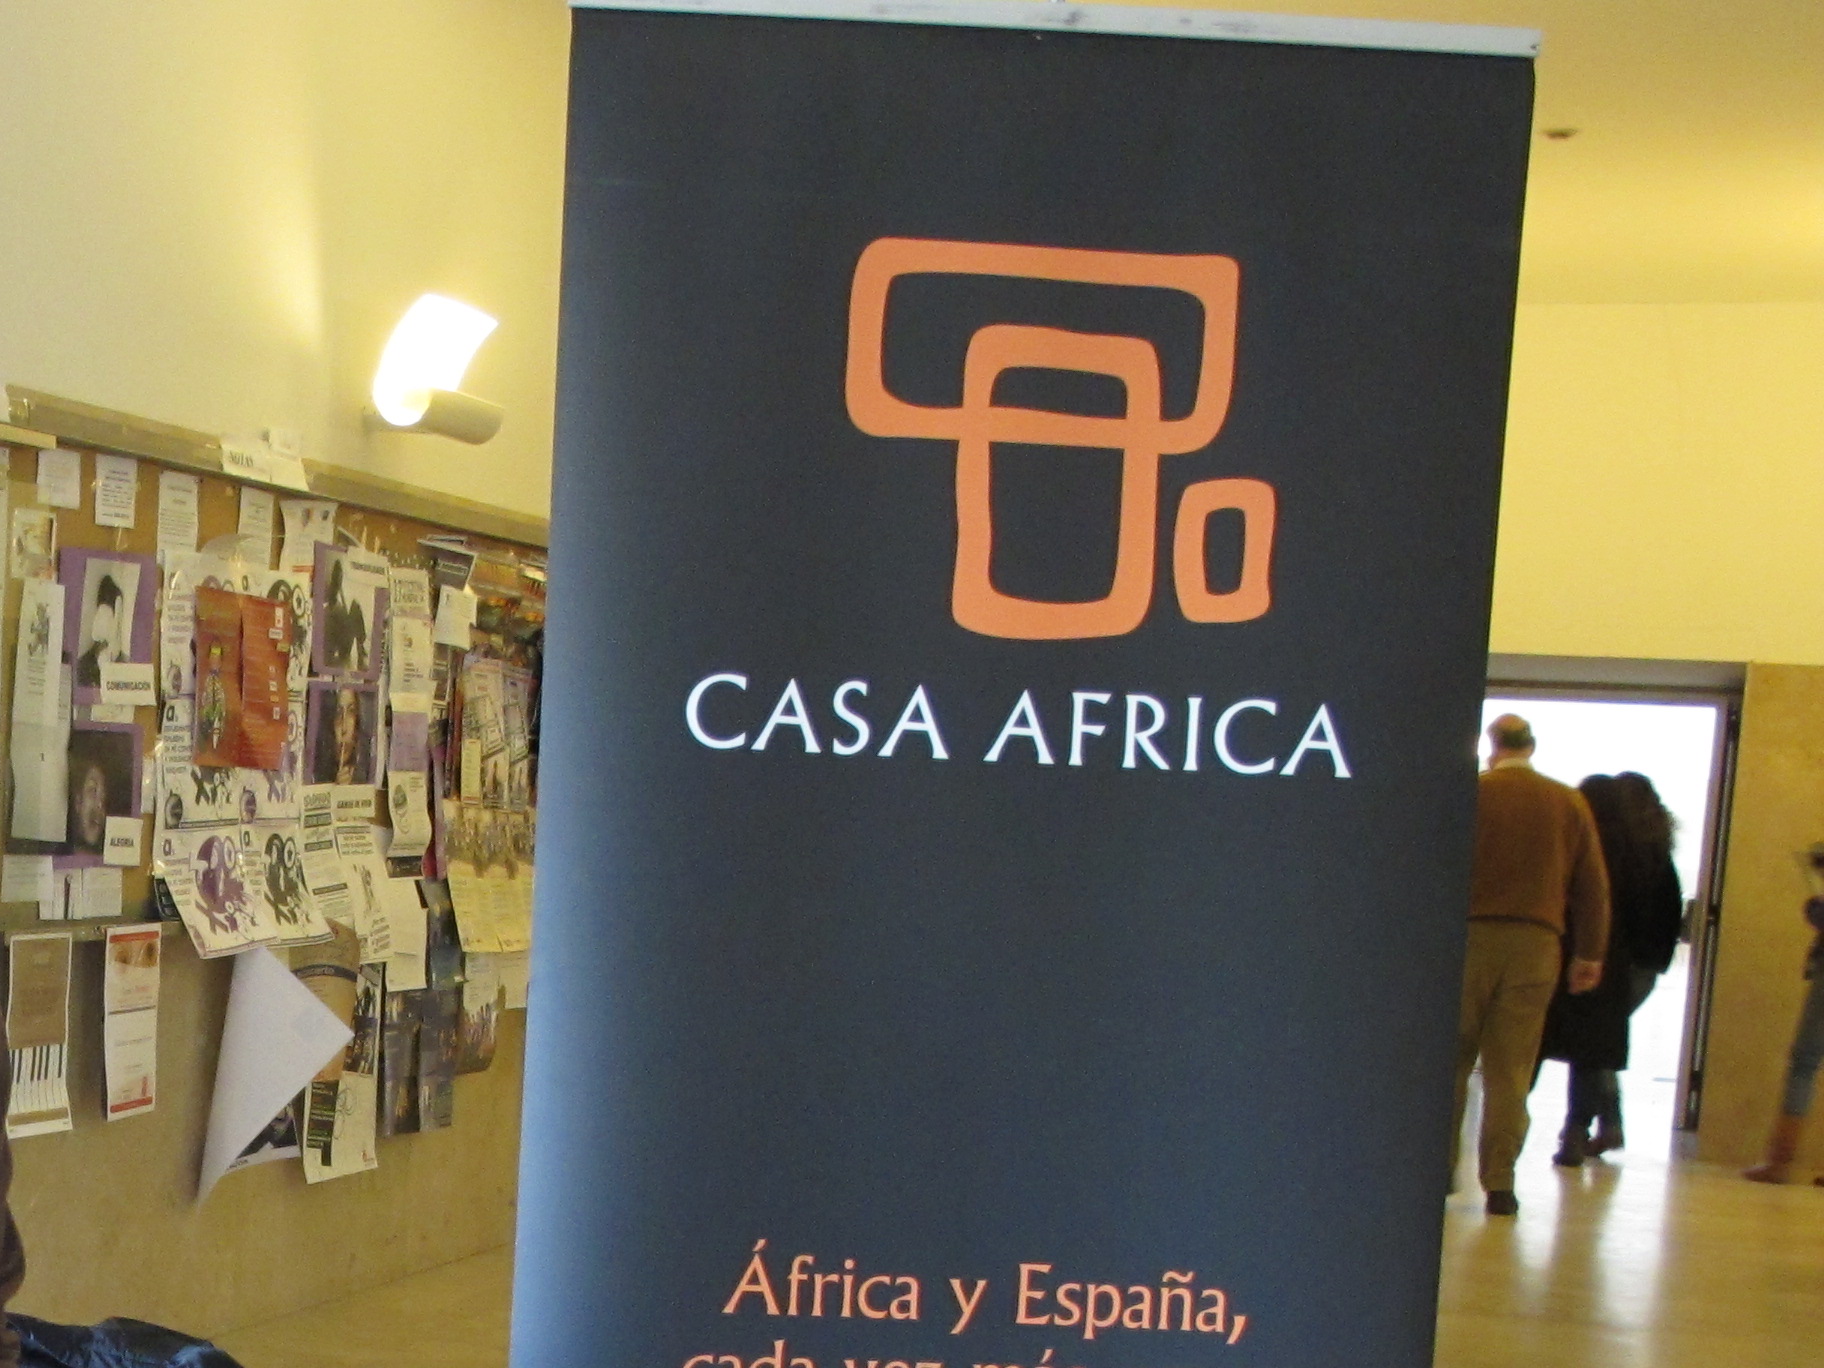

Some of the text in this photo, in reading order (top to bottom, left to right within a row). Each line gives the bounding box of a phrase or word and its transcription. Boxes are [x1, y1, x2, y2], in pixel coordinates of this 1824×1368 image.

[685, 672, 1353, 779] CASA AFRICA
[722, 1239, 1248, 1345] África y España,
